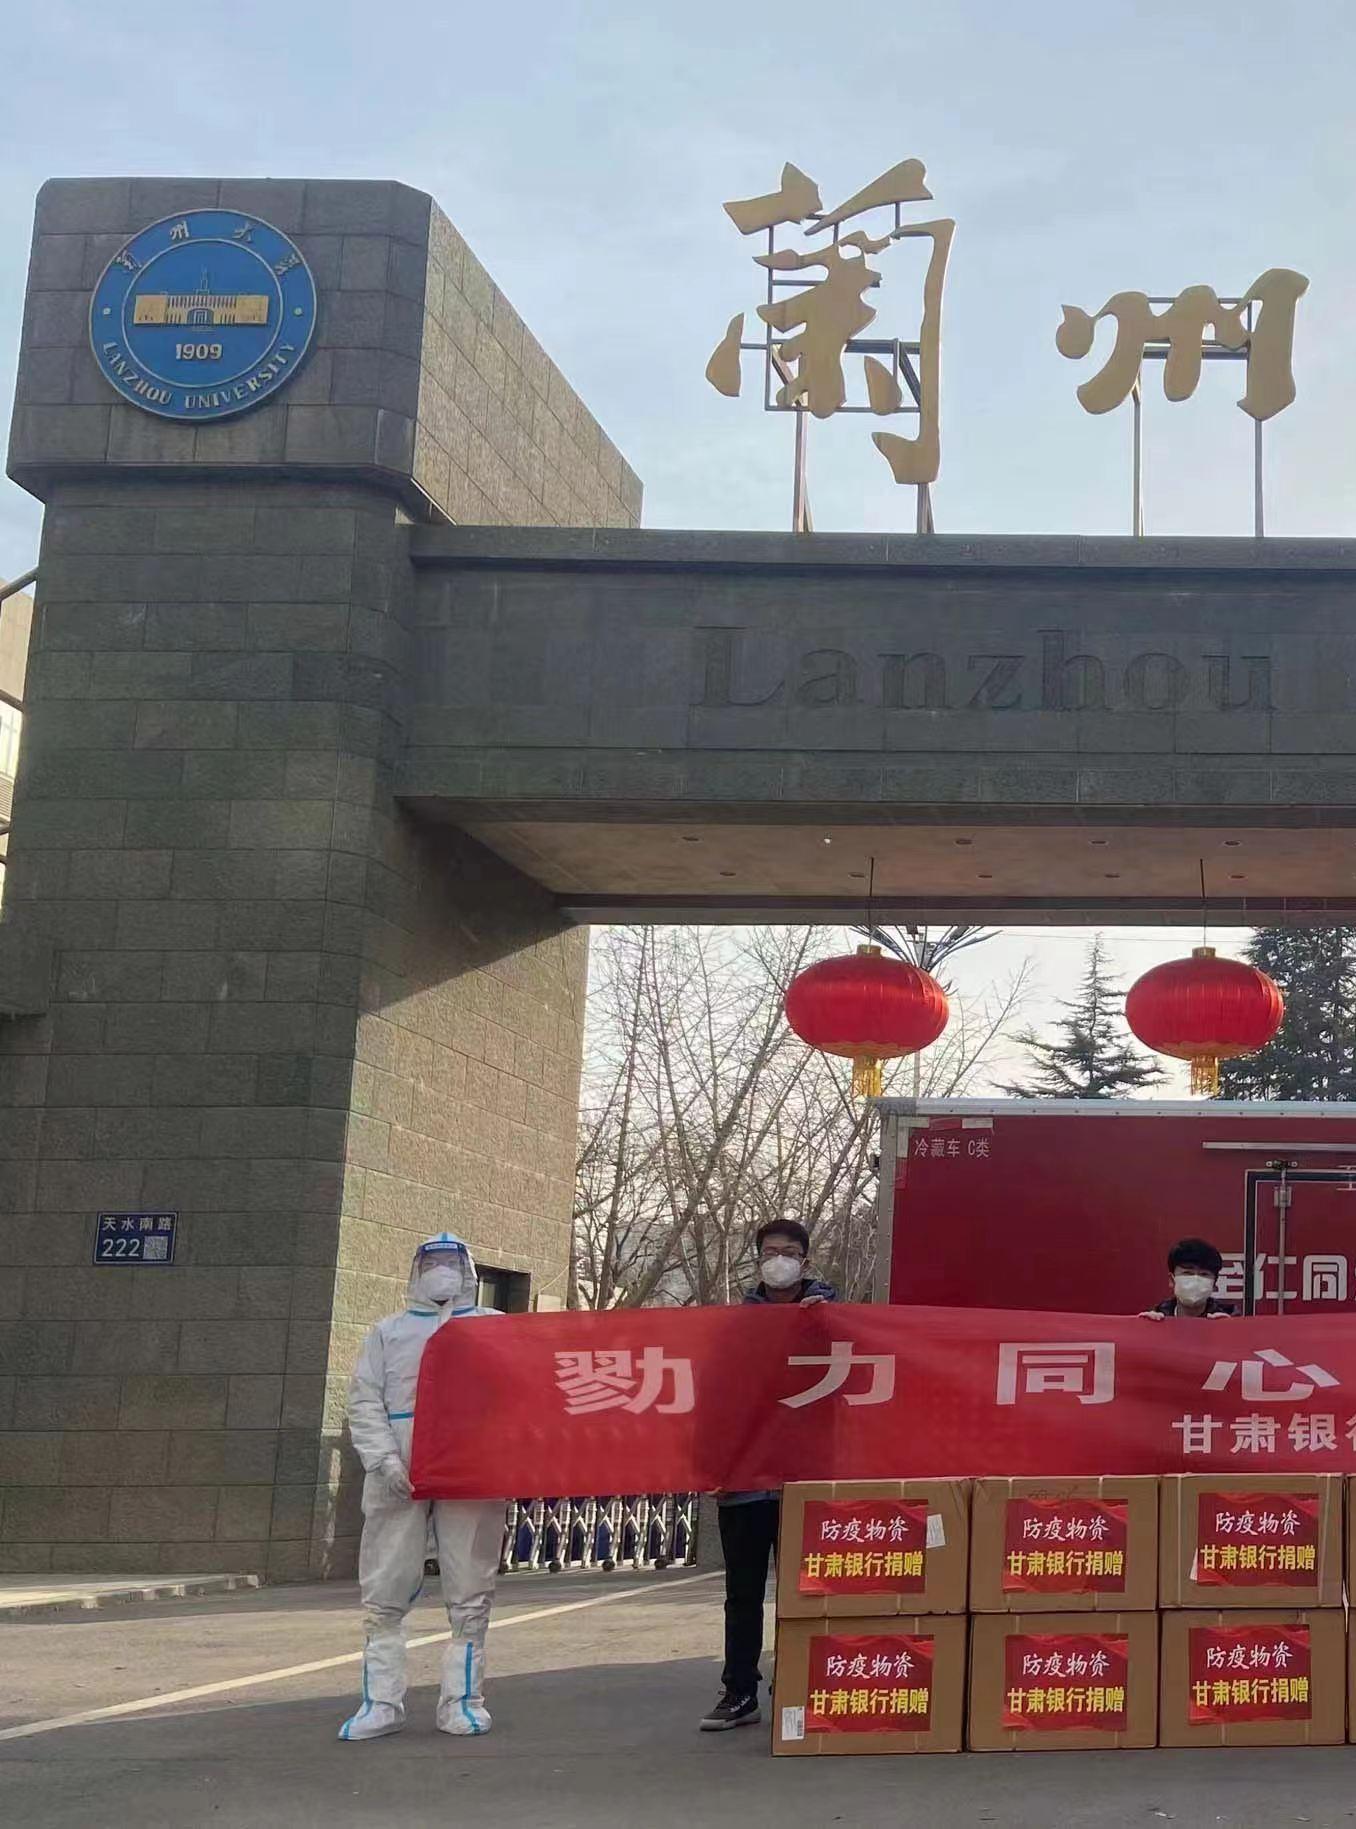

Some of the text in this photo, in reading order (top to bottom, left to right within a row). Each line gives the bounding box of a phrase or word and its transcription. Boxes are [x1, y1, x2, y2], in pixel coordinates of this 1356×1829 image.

[175, 343, 223, 361] 1909
[102, 340, 295, 410] LANZHOU UNIVERSITY
[689, 625, 1278, 711] Lanzhou
[914, 1137, 990, 1158] 冷藏车 C类
[102, 1216, 172, 1231] 天水南路
[102, 1238, 140, 1257] 222
[822, 1515, 911, 1542] 防疫物资
[1023, 1515, 1110, 1541] 防疫物资
[1216, 1509, 1301, 1536] 防疫物资
[804, 1551, 924, 1578] 甘肃银行捐赠
[1007, 1550, 1124, 1576] 甘肃银行捐赠
[1200, 1544, 1316, 1571] 甘肃银行捐赠
[826, 1651, 915, 1679] 防疫物资
[1023, 1650, 1110, 1678] 防疫物资
[1206, 1642, 1293, 1670] 防疫物资
[810, 1688, 930, 1715] 甘肃银行捐赠
[1007, 1686, 1125, 1714] 甘肃银行捐赠
[1192, 1677, 1310, 1707] 甘肃银行捐赠
